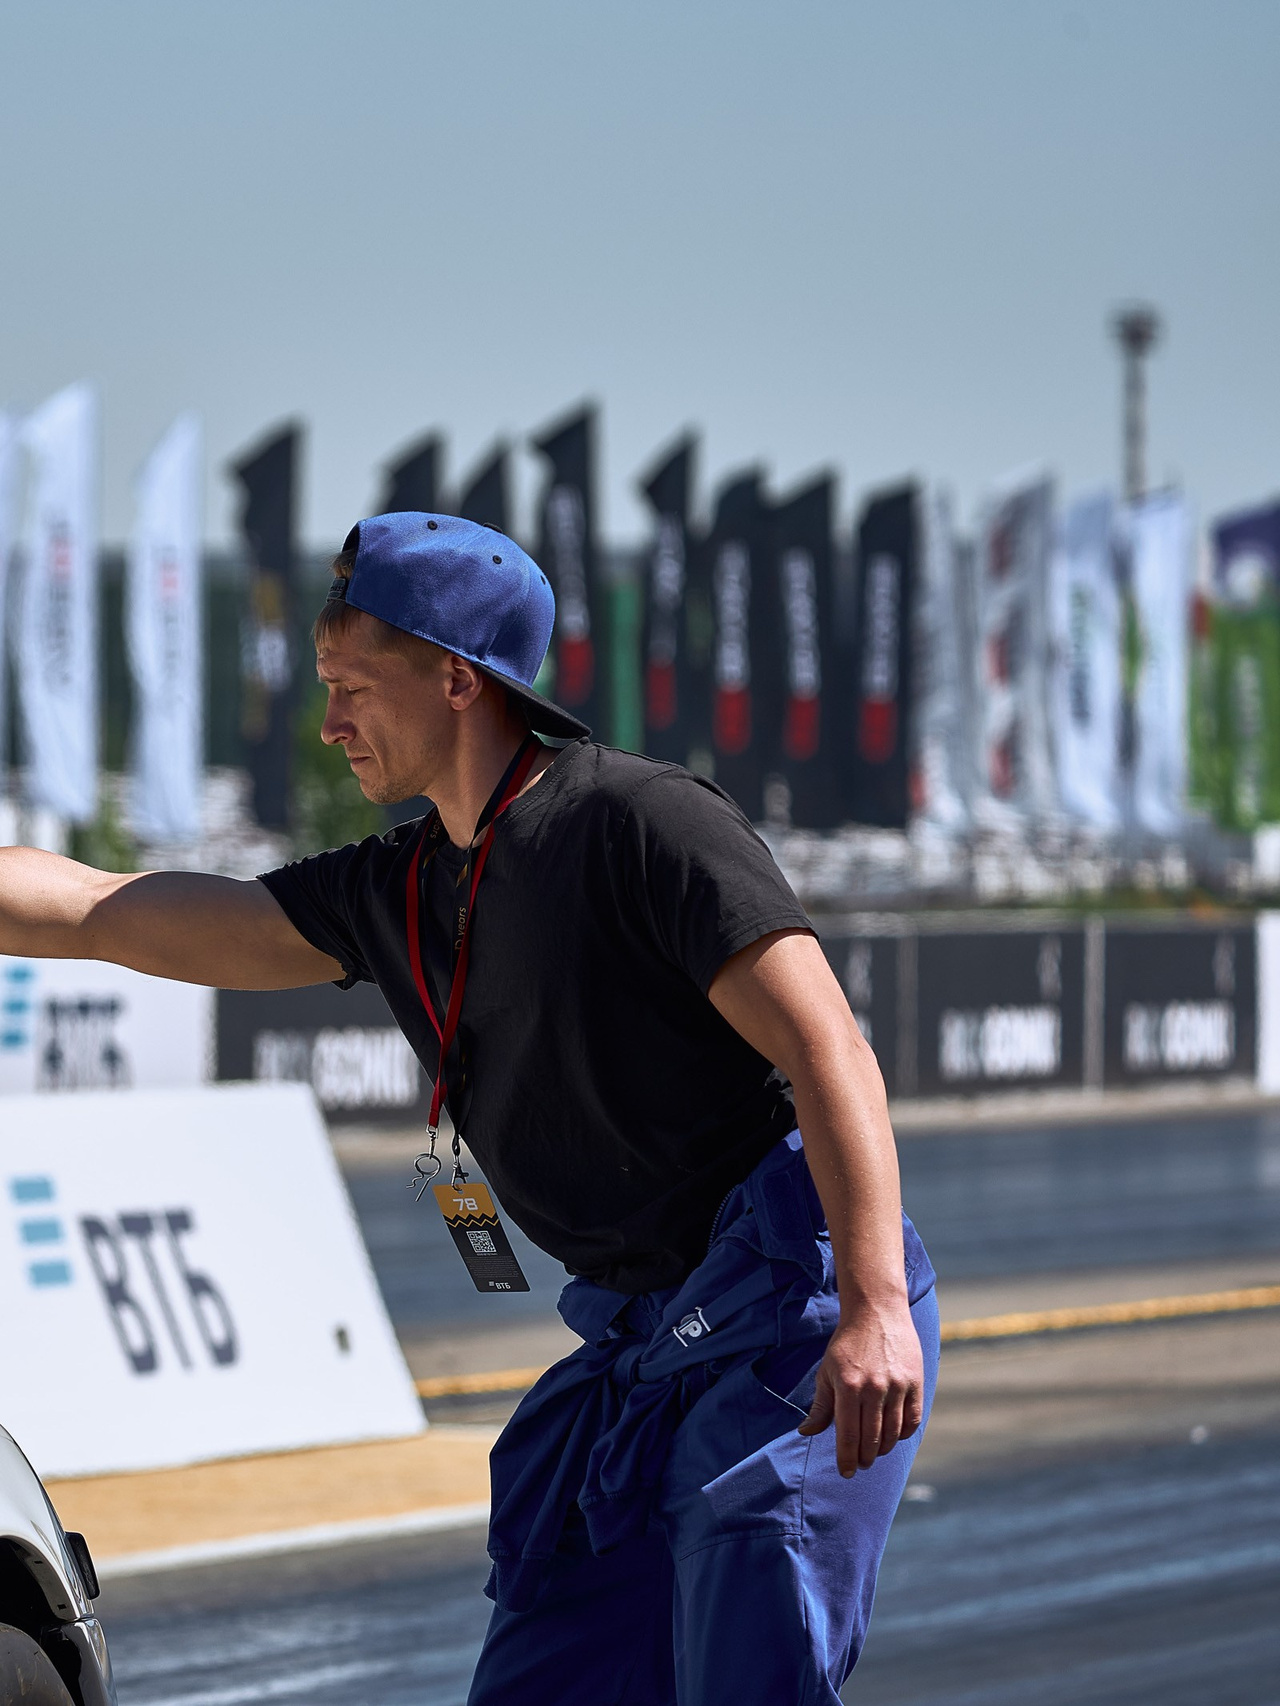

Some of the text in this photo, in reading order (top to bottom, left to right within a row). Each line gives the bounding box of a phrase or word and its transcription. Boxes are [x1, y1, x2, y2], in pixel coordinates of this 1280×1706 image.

[453, 1198, 478, 1211] 78
[495, 1281, 511, 1290] ВТБ
[77, 1208, 238, 1377] ВТБ
